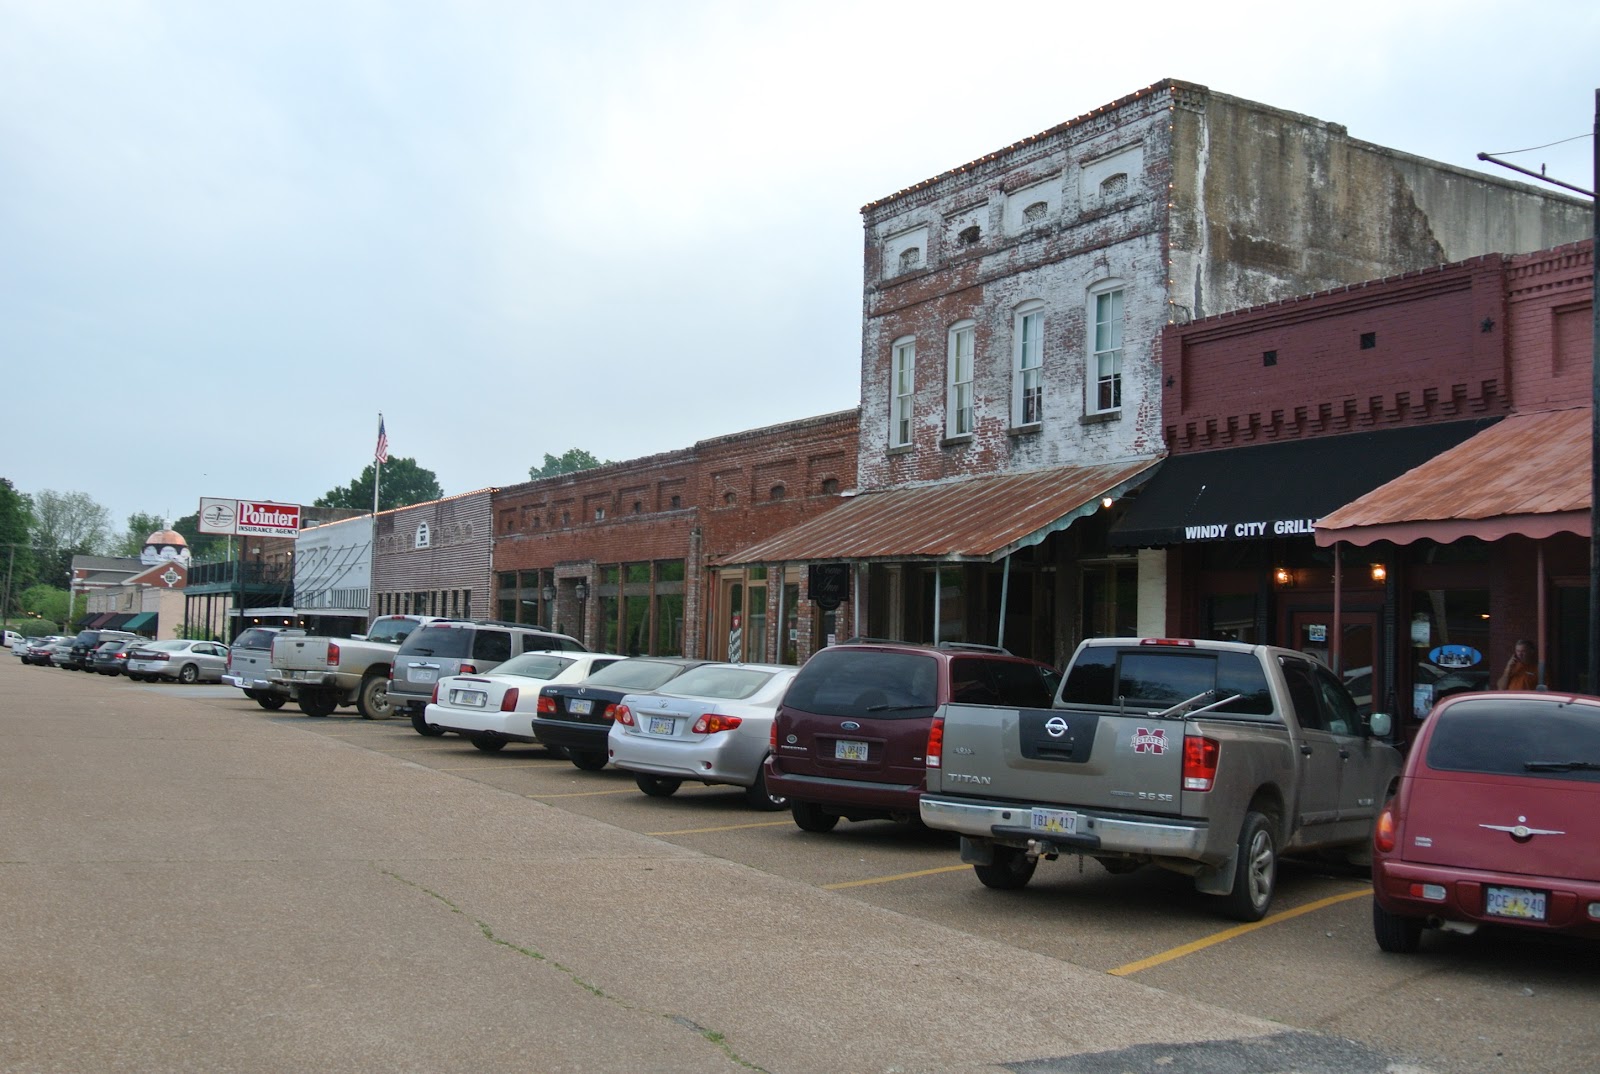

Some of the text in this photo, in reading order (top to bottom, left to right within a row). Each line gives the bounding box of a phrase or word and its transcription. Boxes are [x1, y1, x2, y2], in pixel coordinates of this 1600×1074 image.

[240, 502, 298, 526] Pointer
[238, 526, 272, 534] INSURANCE
[1185, 524, 1228, 539] WINDY
[1234, 522, 1267, 537] CITY
[1136, 735, 1163, 746] STATE
[948, 773, 991, 785] TITAN
[1033, 814, 1076, 831] TB1 417
[1488, 893, 1509, 908] PCE
